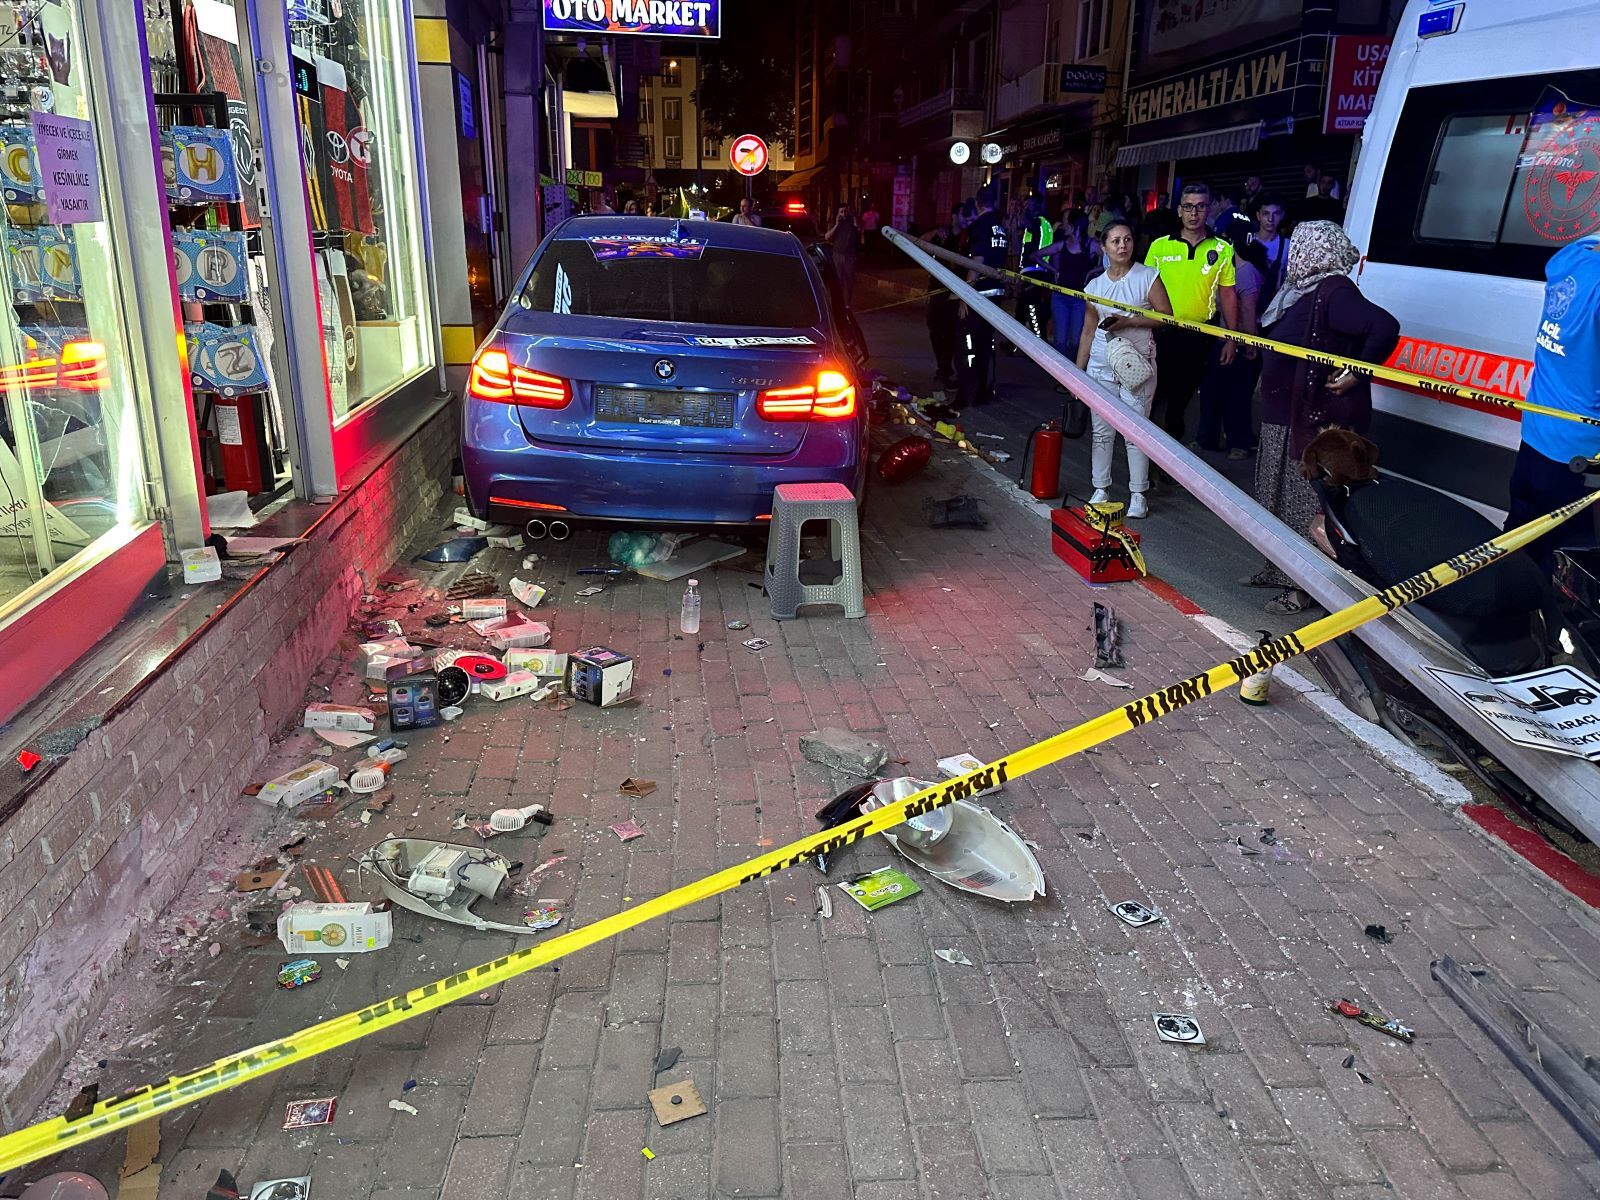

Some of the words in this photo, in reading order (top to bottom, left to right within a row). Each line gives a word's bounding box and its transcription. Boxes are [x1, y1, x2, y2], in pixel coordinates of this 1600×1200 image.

[552, 0, 606, 22] OTO
[611, 0, 711, 27] MARKET
[1128, 67, 1230, 124] KEMERALTI
[1231, 50, 1288, 102] AVM
[37, 121, 60, 139] İYECEK
[57, 146, 79, 160] GİRMEK
[53, 168, 90, 187] KESİNLİKLE
[1395, 341, 1535, 398] AMBULAN
